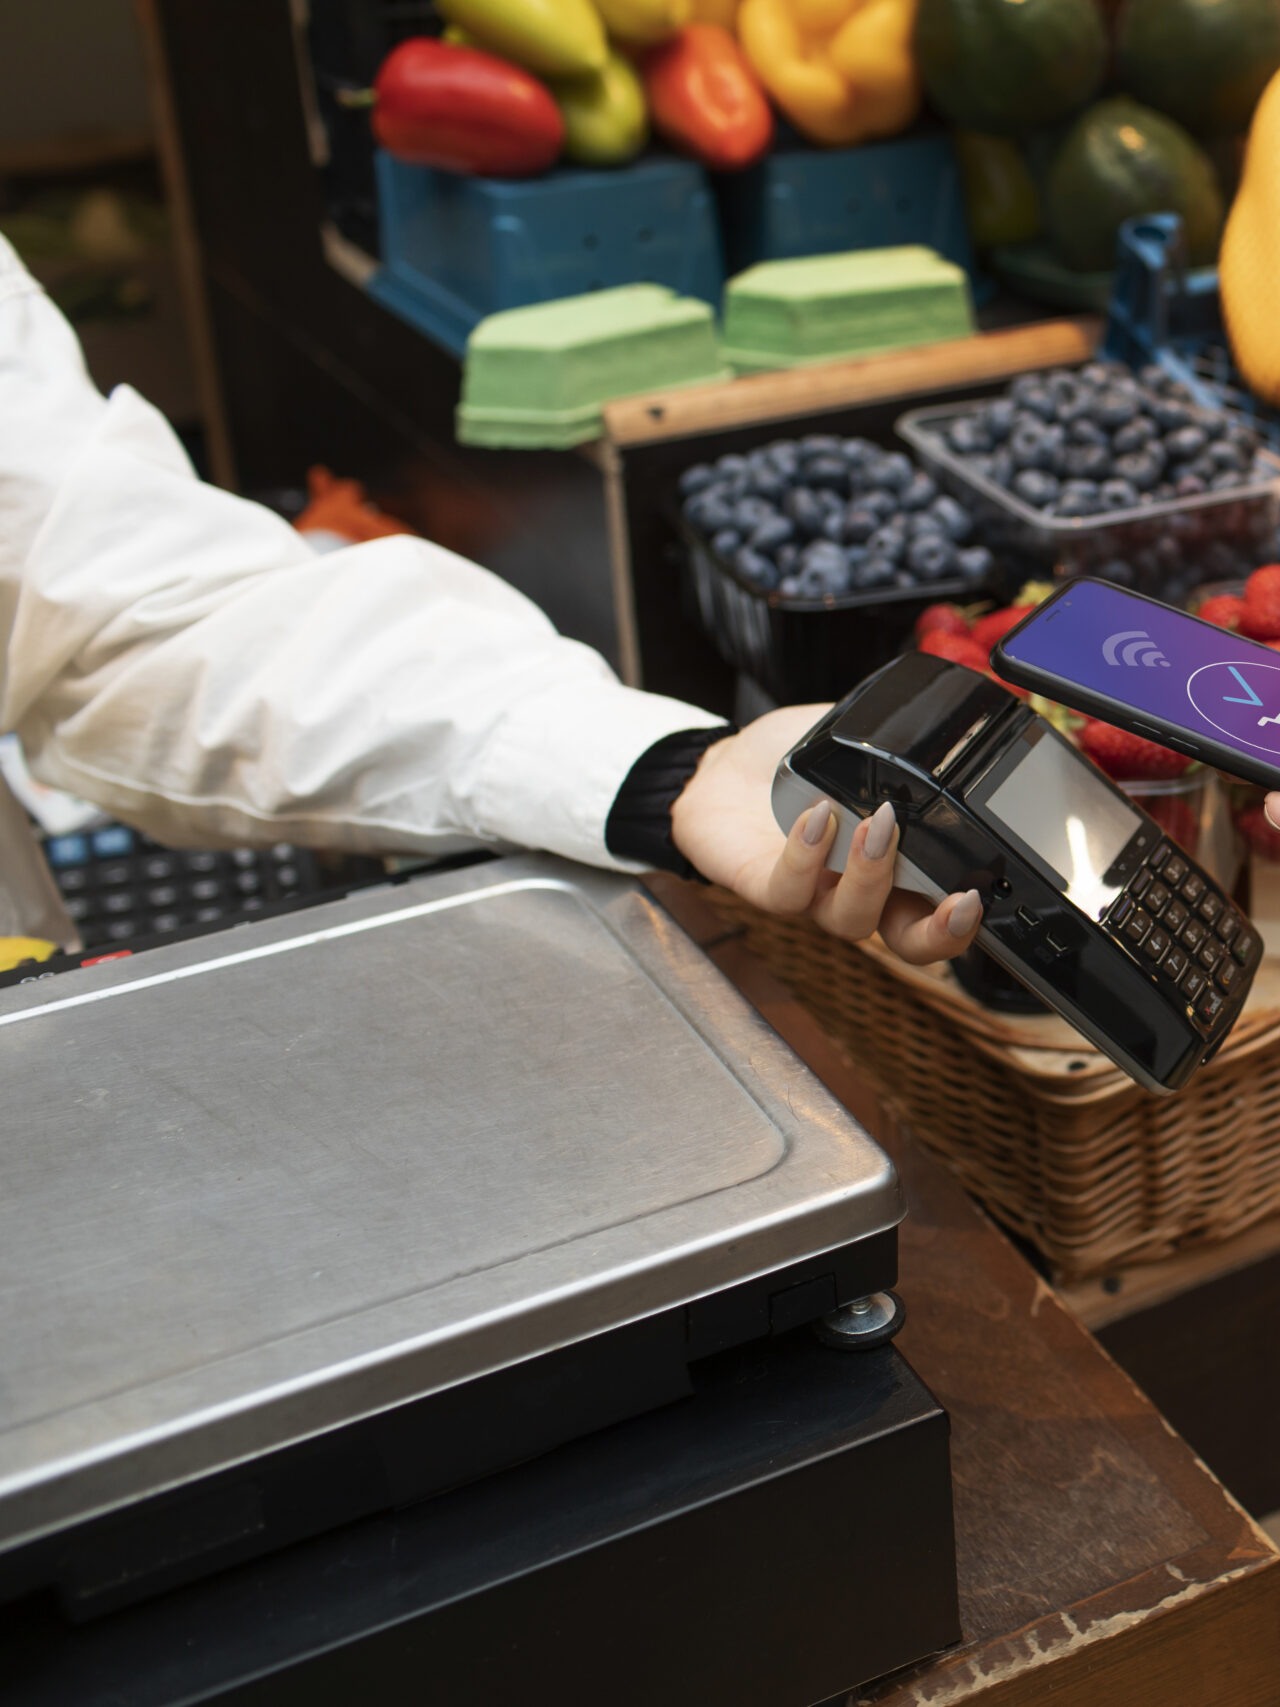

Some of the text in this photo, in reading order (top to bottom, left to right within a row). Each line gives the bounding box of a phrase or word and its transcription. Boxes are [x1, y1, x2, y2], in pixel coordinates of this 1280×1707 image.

[1168, 867, 1179, 879] 3
[1150, 893, 1161, 905] 2
[1168, 911, 1179, 924] 5
[1131, 922, 1143, 933] 1
[1185, 930, 1196, 942] 8
[1150, 940, 1161, 950] 4
[1167, 958, 1178, 970] 7
